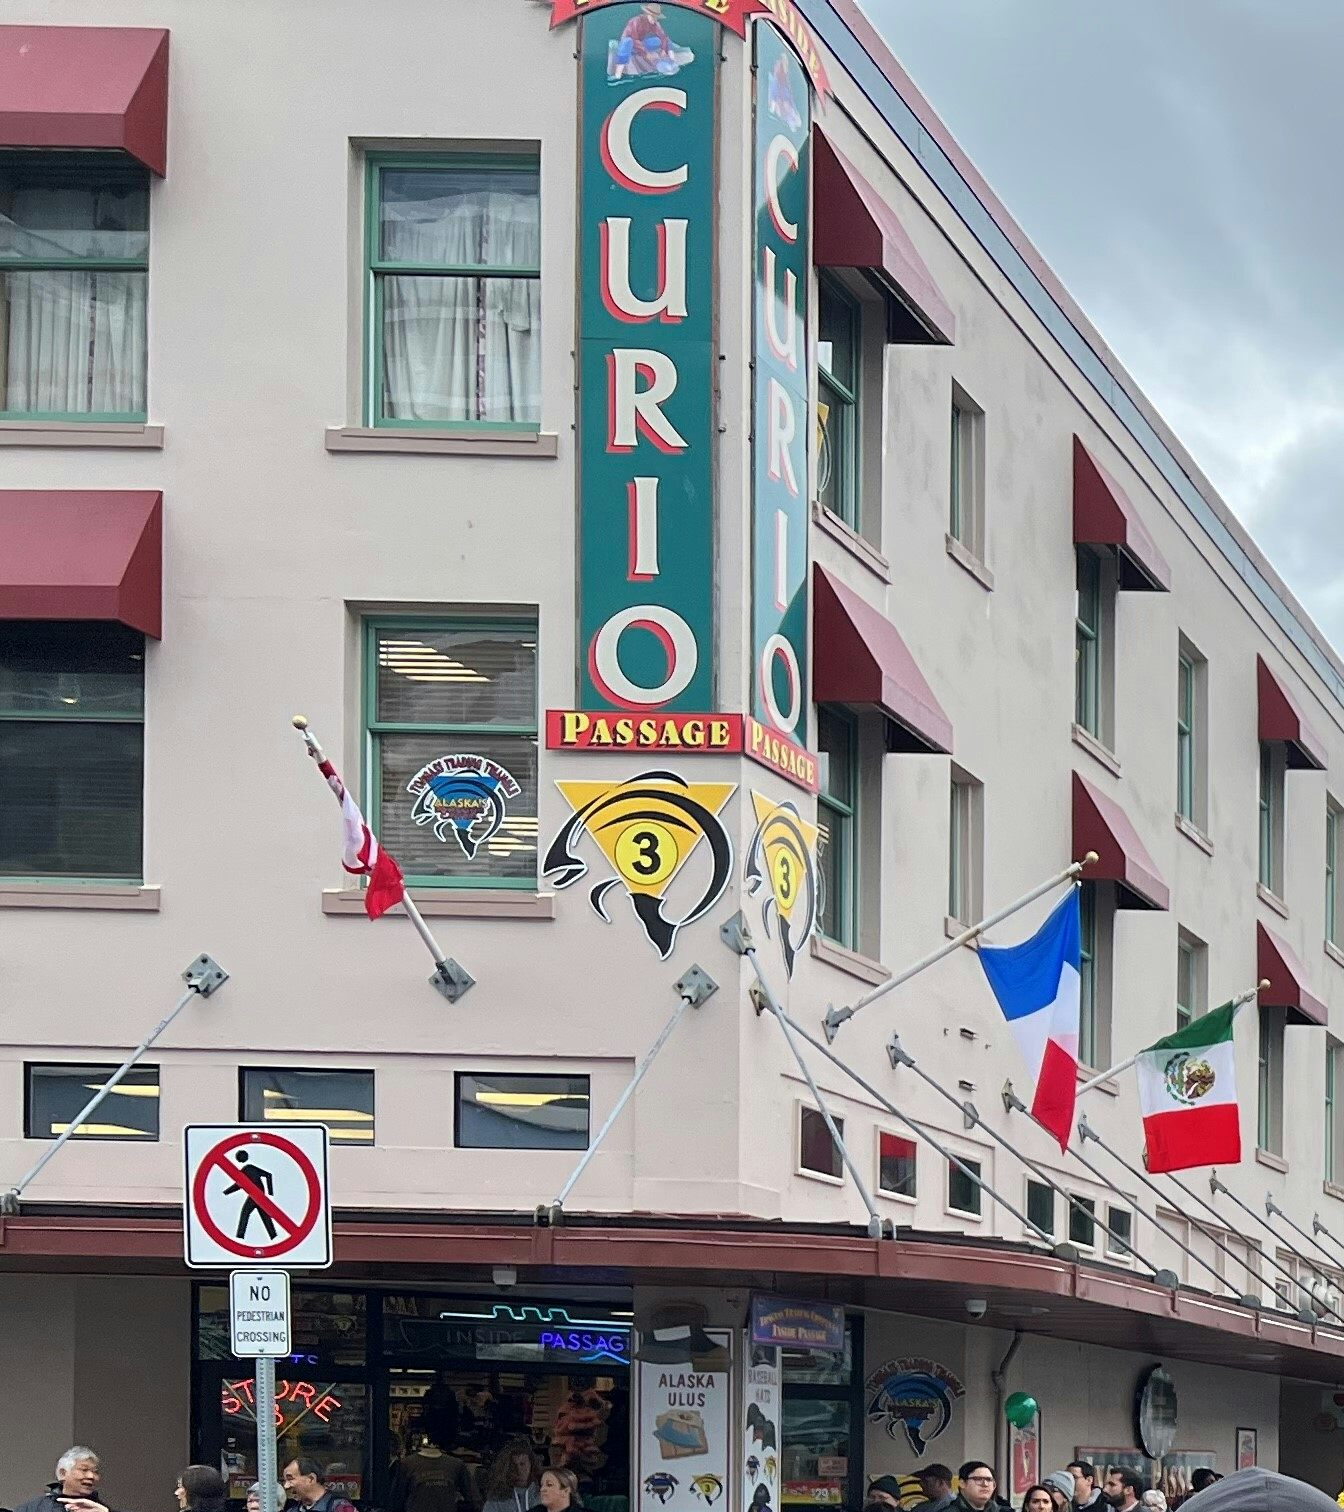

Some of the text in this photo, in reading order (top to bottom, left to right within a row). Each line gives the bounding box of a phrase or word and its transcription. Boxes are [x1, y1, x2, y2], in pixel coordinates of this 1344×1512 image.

[590, 86, 699, 710] CURIO
[760, 134, 802, 736] CURIO
[562, 712, 730, 747] PASSAGE
[750, 721, 815, 785] PASSAGE
[631, 831, 662, 876] 3
[780, 857, 792, 899] 3
[249, 1285, 271, 1301] NO
[237, 1310, 285, 1322] PEDESTRIAN
[236, 1331, 286, 1343] CROSSING
[540, 1331, 630, 1352] PASSAG
[658, 1373, 715, 1389] ALASKA
[668, 1392, 706, 1407] ULUS
